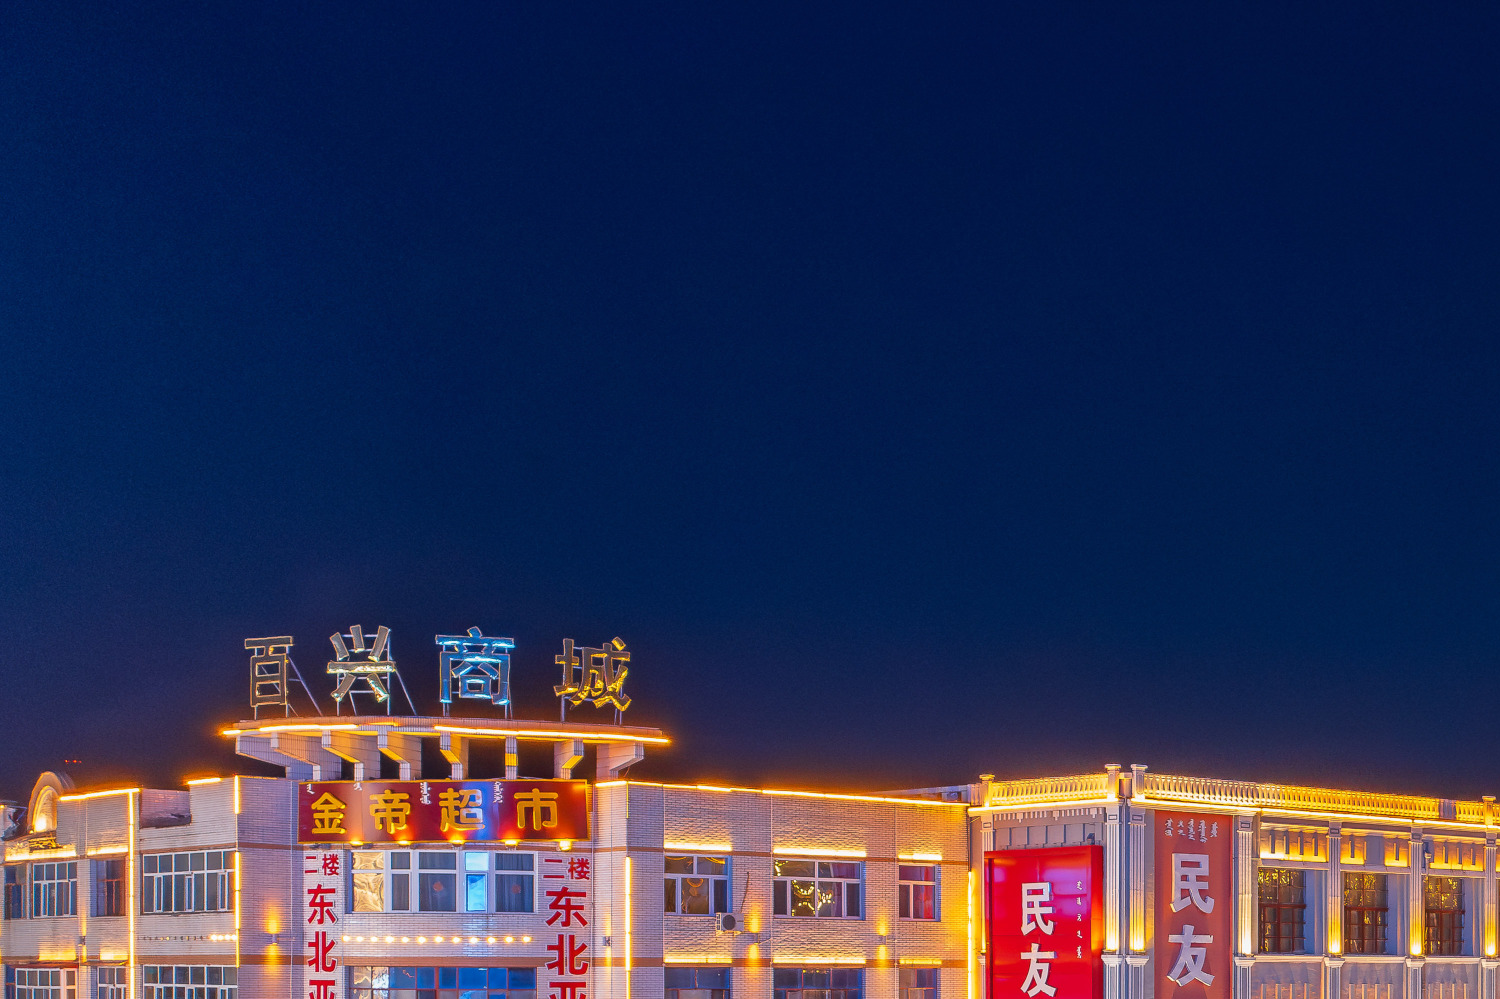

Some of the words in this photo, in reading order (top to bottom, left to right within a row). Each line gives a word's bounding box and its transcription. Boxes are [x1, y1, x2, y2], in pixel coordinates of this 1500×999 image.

[244, 624, 631, 711] 百兴商城
[311, 787, 559, 835] 金帝超市
[304, 853, 340, 876] 二楼
[542, 857, 590, 882] 二楼
